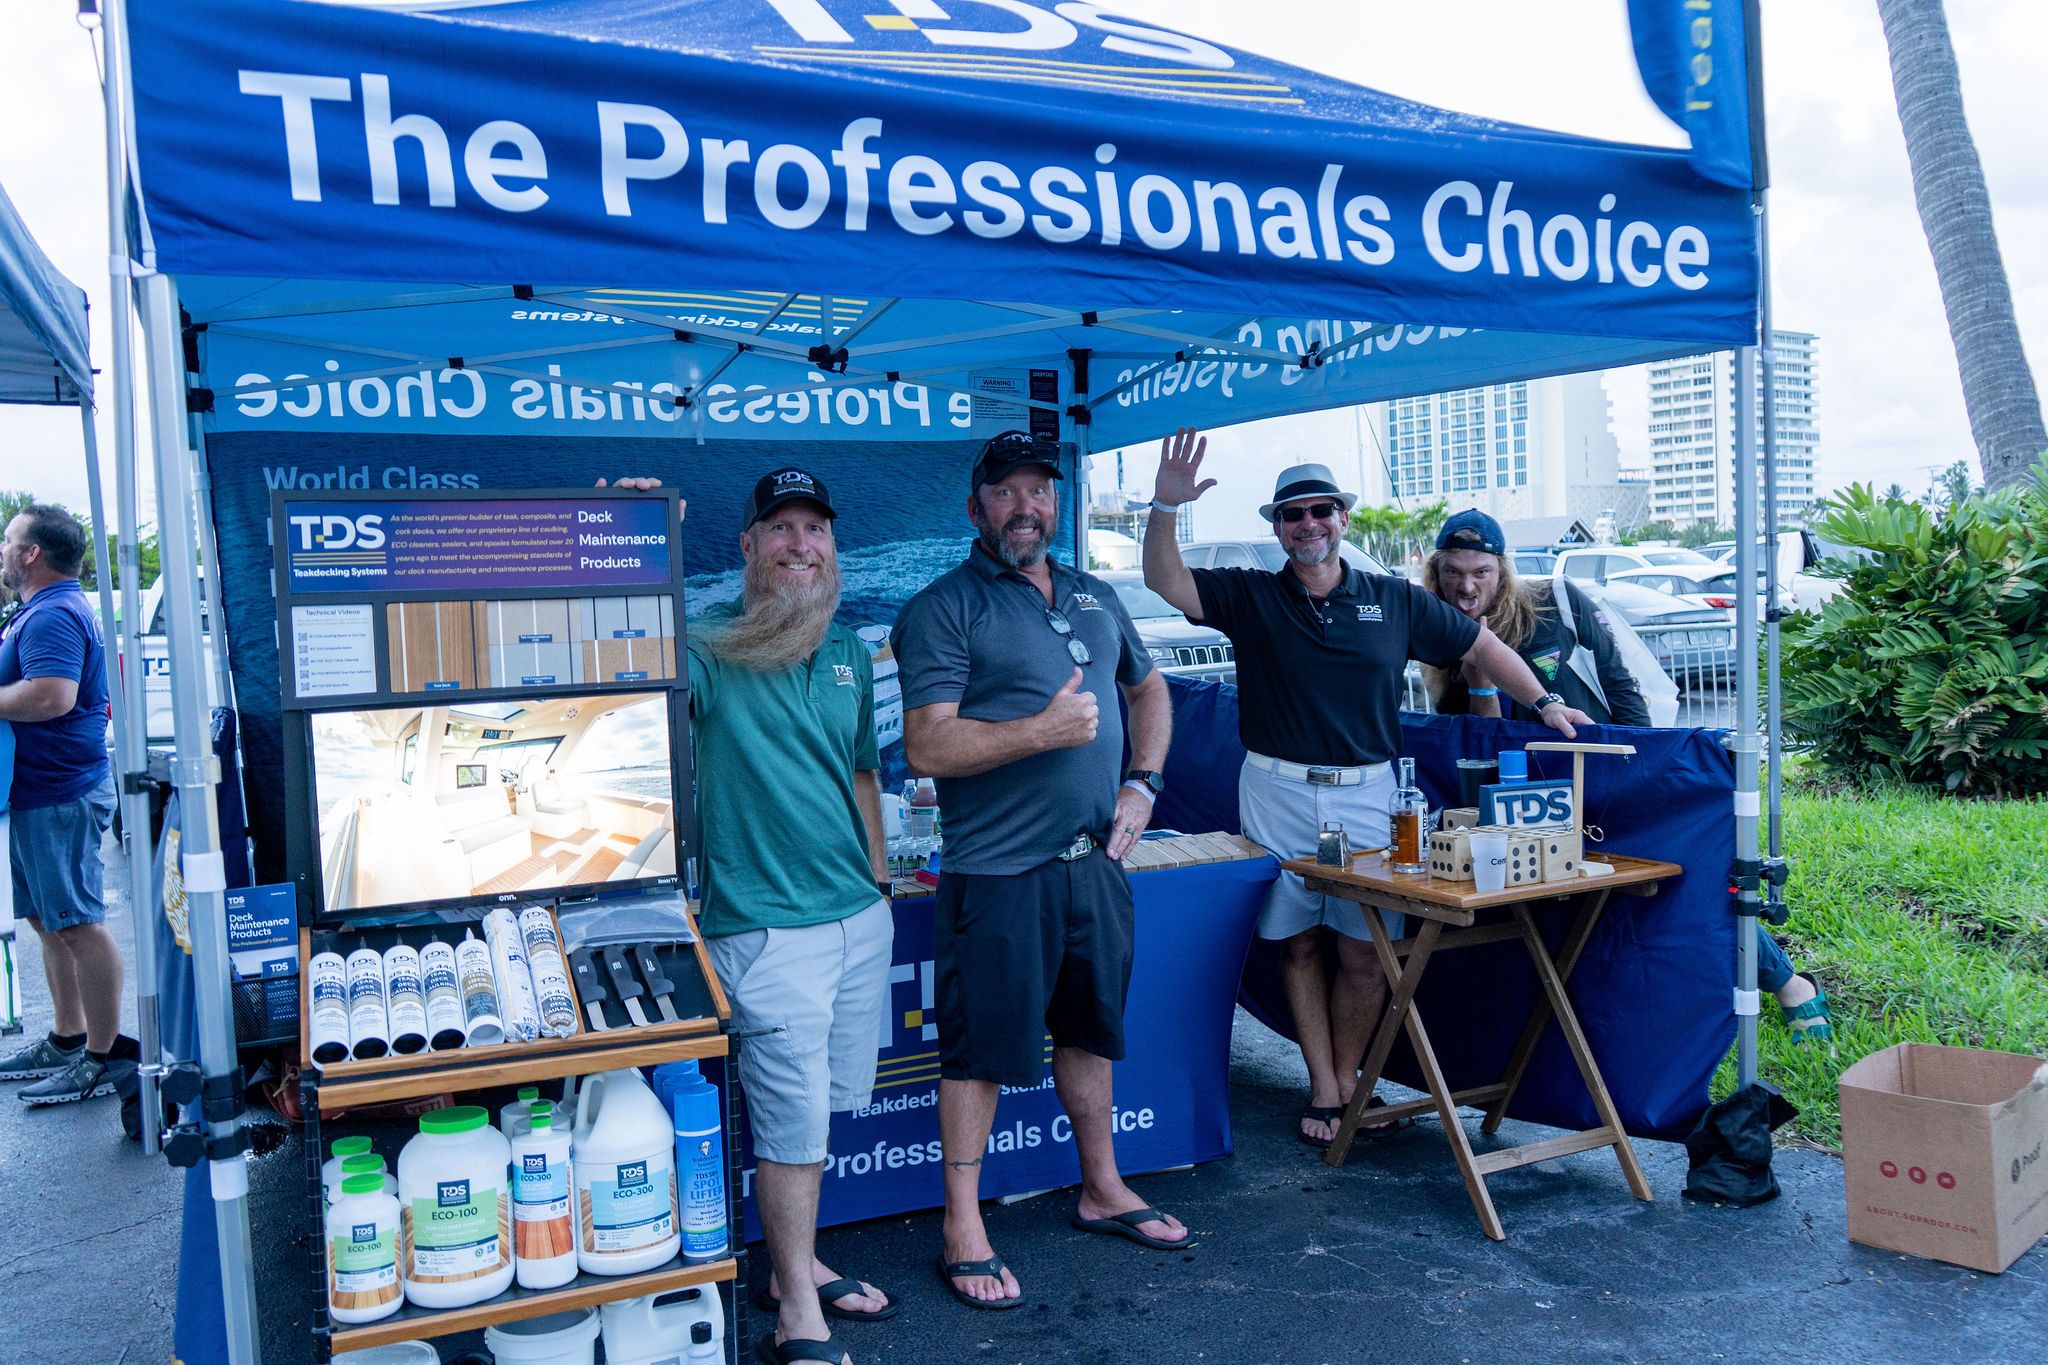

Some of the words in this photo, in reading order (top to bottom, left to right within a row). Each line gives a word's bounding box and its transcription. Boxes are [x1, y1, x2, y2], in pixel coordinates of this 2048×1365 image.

[238, 70, 549, 212] The
[597, 101, 1395, 266] Professionals
[1421, 180, 1709, 290] Choice
[262, 465, 370, 490] World
[382, 466, 480, 490] Class
[772, 471, 813, 485] TDS
[441, 514, 468, 522] premier
[578, 510, 613, 523] Deck
[290, 514, 386, 550] TDS
[479, 527, 517, 535] proprietary
[579, 533, 666, 546] Maintenance
[472, 552, 529, 561] uncompromising
[581, 556, 641, 569] Products
[293, 567, 350, 578] Teakdecking
[351, 567, 388, 577] Systems
[427, 567, 477, 575] manufacturing
[493, 565, 537, 573] maintenance
[1356, 604, 1382, 613] TDS
[1496, 790, 1571, 825] TDS
[228, 896, 245, 905] TDS
[229, 912, 254, 923] Deck
[524, 911, 549, 919] TDS
[230, 917, 290, 931] Maintenance
[231, 928, 272, 939] Products
[391, 955, 416, 964] TDS
[425, 950, 449, 960] TDS
[270, 962, 288, 972] TDS
[316, 960, 343, 970] TDS
[351, 958, 376, 968] TDS
[541, 976, 565, 985] TDS
[1052, 1106, 1154, 1143] Cice
[525, 1157, 544, 1166] TDS
[620, 1165, 644, 1178] TDS
[520, 1173, 551, 1182] ECO-300
[693, 1177, 720, 1190] SPOT
[440, 1184, 467, 1197] TDS
[613, 1184, 654, 1199] ECO-300
[690, 1185, 723, 1200] LIFTER
[432, 1206, 478, 1220] ECO-100
[354, 1225, 374, 1237] TDS
[347, 1242, 382, 1253] ECO-100
